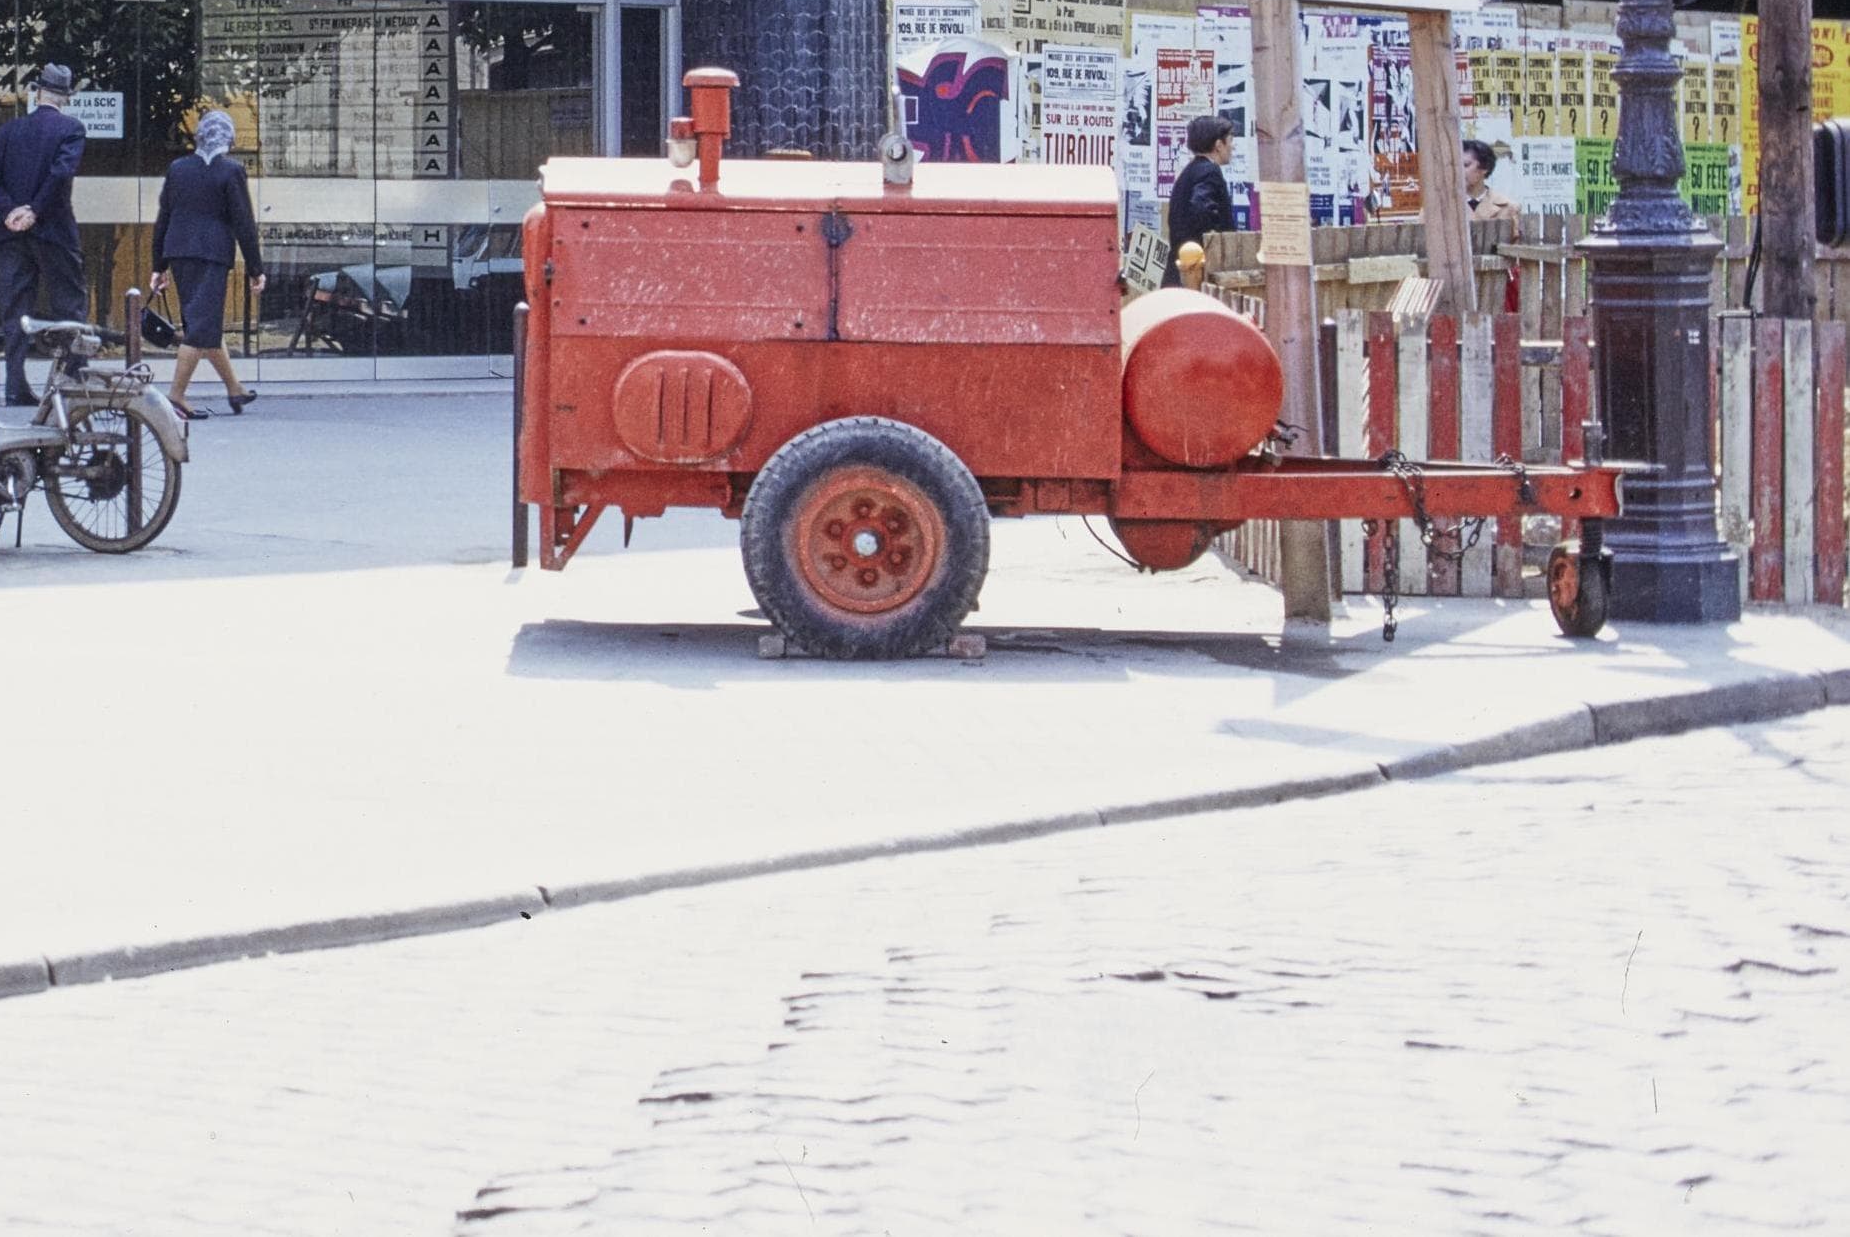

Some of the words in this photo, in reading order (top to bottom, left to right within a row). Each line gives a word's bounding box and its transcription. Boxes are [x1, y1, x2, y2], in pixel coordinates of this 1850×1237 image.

[425, 14, 441, 27] A
[915, 23, 926, 34] RUE
[930, 23, 938, 34] DE
[940, 23, 965, 35] RIVOLI
[425, 38, 441, 51] A
[425, 62, 441, 75] A
[1529, 58, 1551, 68] COMMENT
[1560, 58, 1584, 68] COMMENT
[1062, 68, 1073, 80] RUE
[1076, 68, 1083, 80] DE
[1085, 69, 1108, 81] RIVOLI
[425, 85, 441, 99] A
[94, 98, 116, 107] SCIC
[1530, 94, 1553, 107] BRETON
[1561, 94, 1584, 107] BRETON
[1593, 94, 1616, 108] BRETON
[1685, 101, 1707, 114] BRETON
[1714, 103, 1735, 115] BRETON
[425, 110, 441, 123] A
[1046, 113, 1062, 124] SUR
[1066, 114, 1079, 126] LES
[1084, 115, 1114, 128] ROUTES
[1538, 108, 1546, 134] ?
[1569, 108, 1577, 134] ?
[1600, 109, 1608, 135] ?
[1692, 115, 1700, 141] ?
[1720, 117, 1728, 142] ?
[425, 134, 441, 147] A
[425, 159, 441, 171] A
[1587, 158, 1600, 185] 50
[1691, 163, 1702, 189] 50
[424, 230, 440, 242] H
